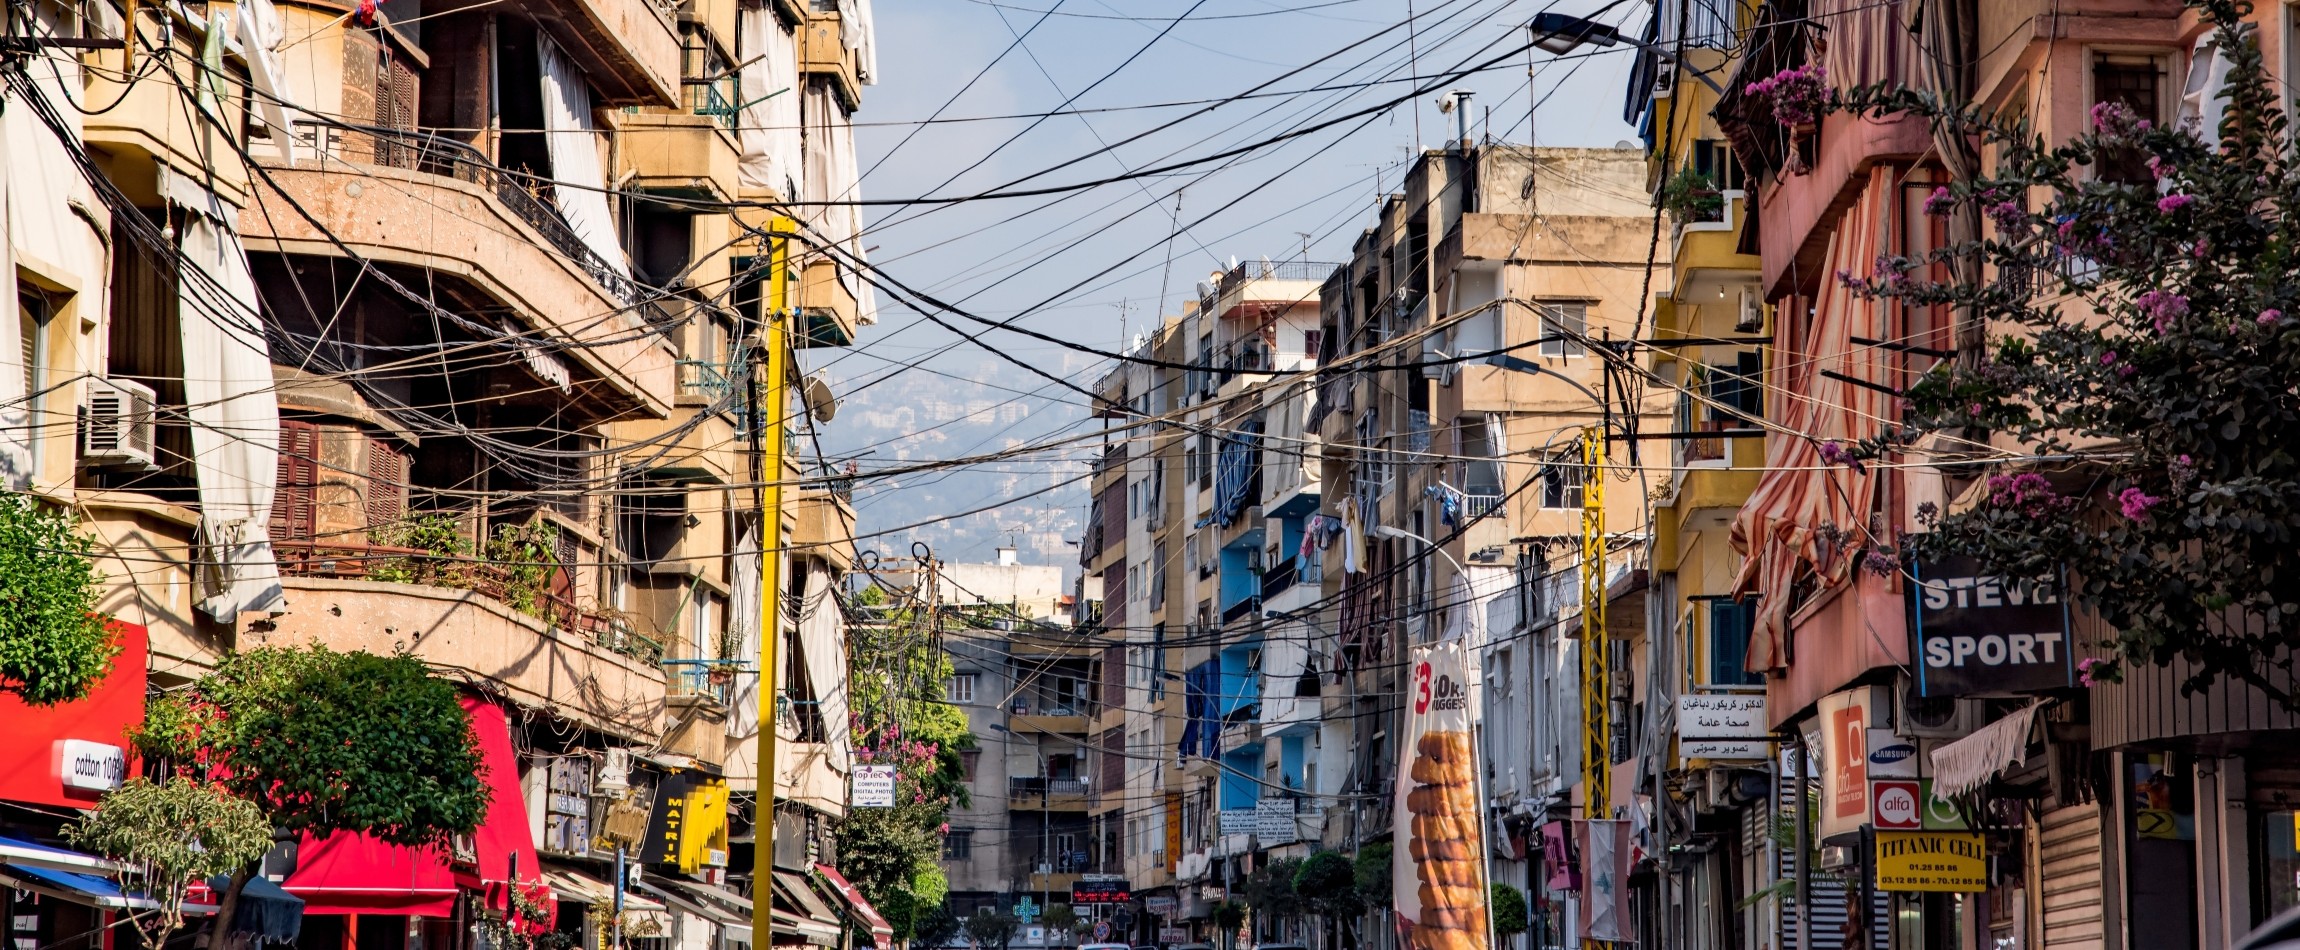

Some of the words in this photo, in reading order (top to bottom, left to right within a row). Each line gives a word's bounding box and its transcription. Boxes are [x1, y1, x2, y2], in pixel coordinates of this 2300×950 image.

[1925, 632, 2062, 668] SPORT
[1711, 699, 1737, 711] كريكور
[1739, 699, 1764, 711] الدكتور
[1698, 716, 1720, 727] عامة
[1725, 716, 1750, 727] صحة
[1721, 744, 1749, 754] تصوير
[1875, 749, 1911, 759] SAMSUNG
[75, 753, 100, 778] cotton
[1838, 765, 1850, 794] alfa
[1884, 796, 1910, 811] alfa
[664, 798, 682, 863] MATRIX
[1880, 837, 1945, 859] TITANIC
[1949, 839, 1985, 862] CELL
[1909, 863, 1932, 871] 01.25
[1882, 876, 1905, 884] 03.12
[1937, 877, 1961, 885] 70.12
